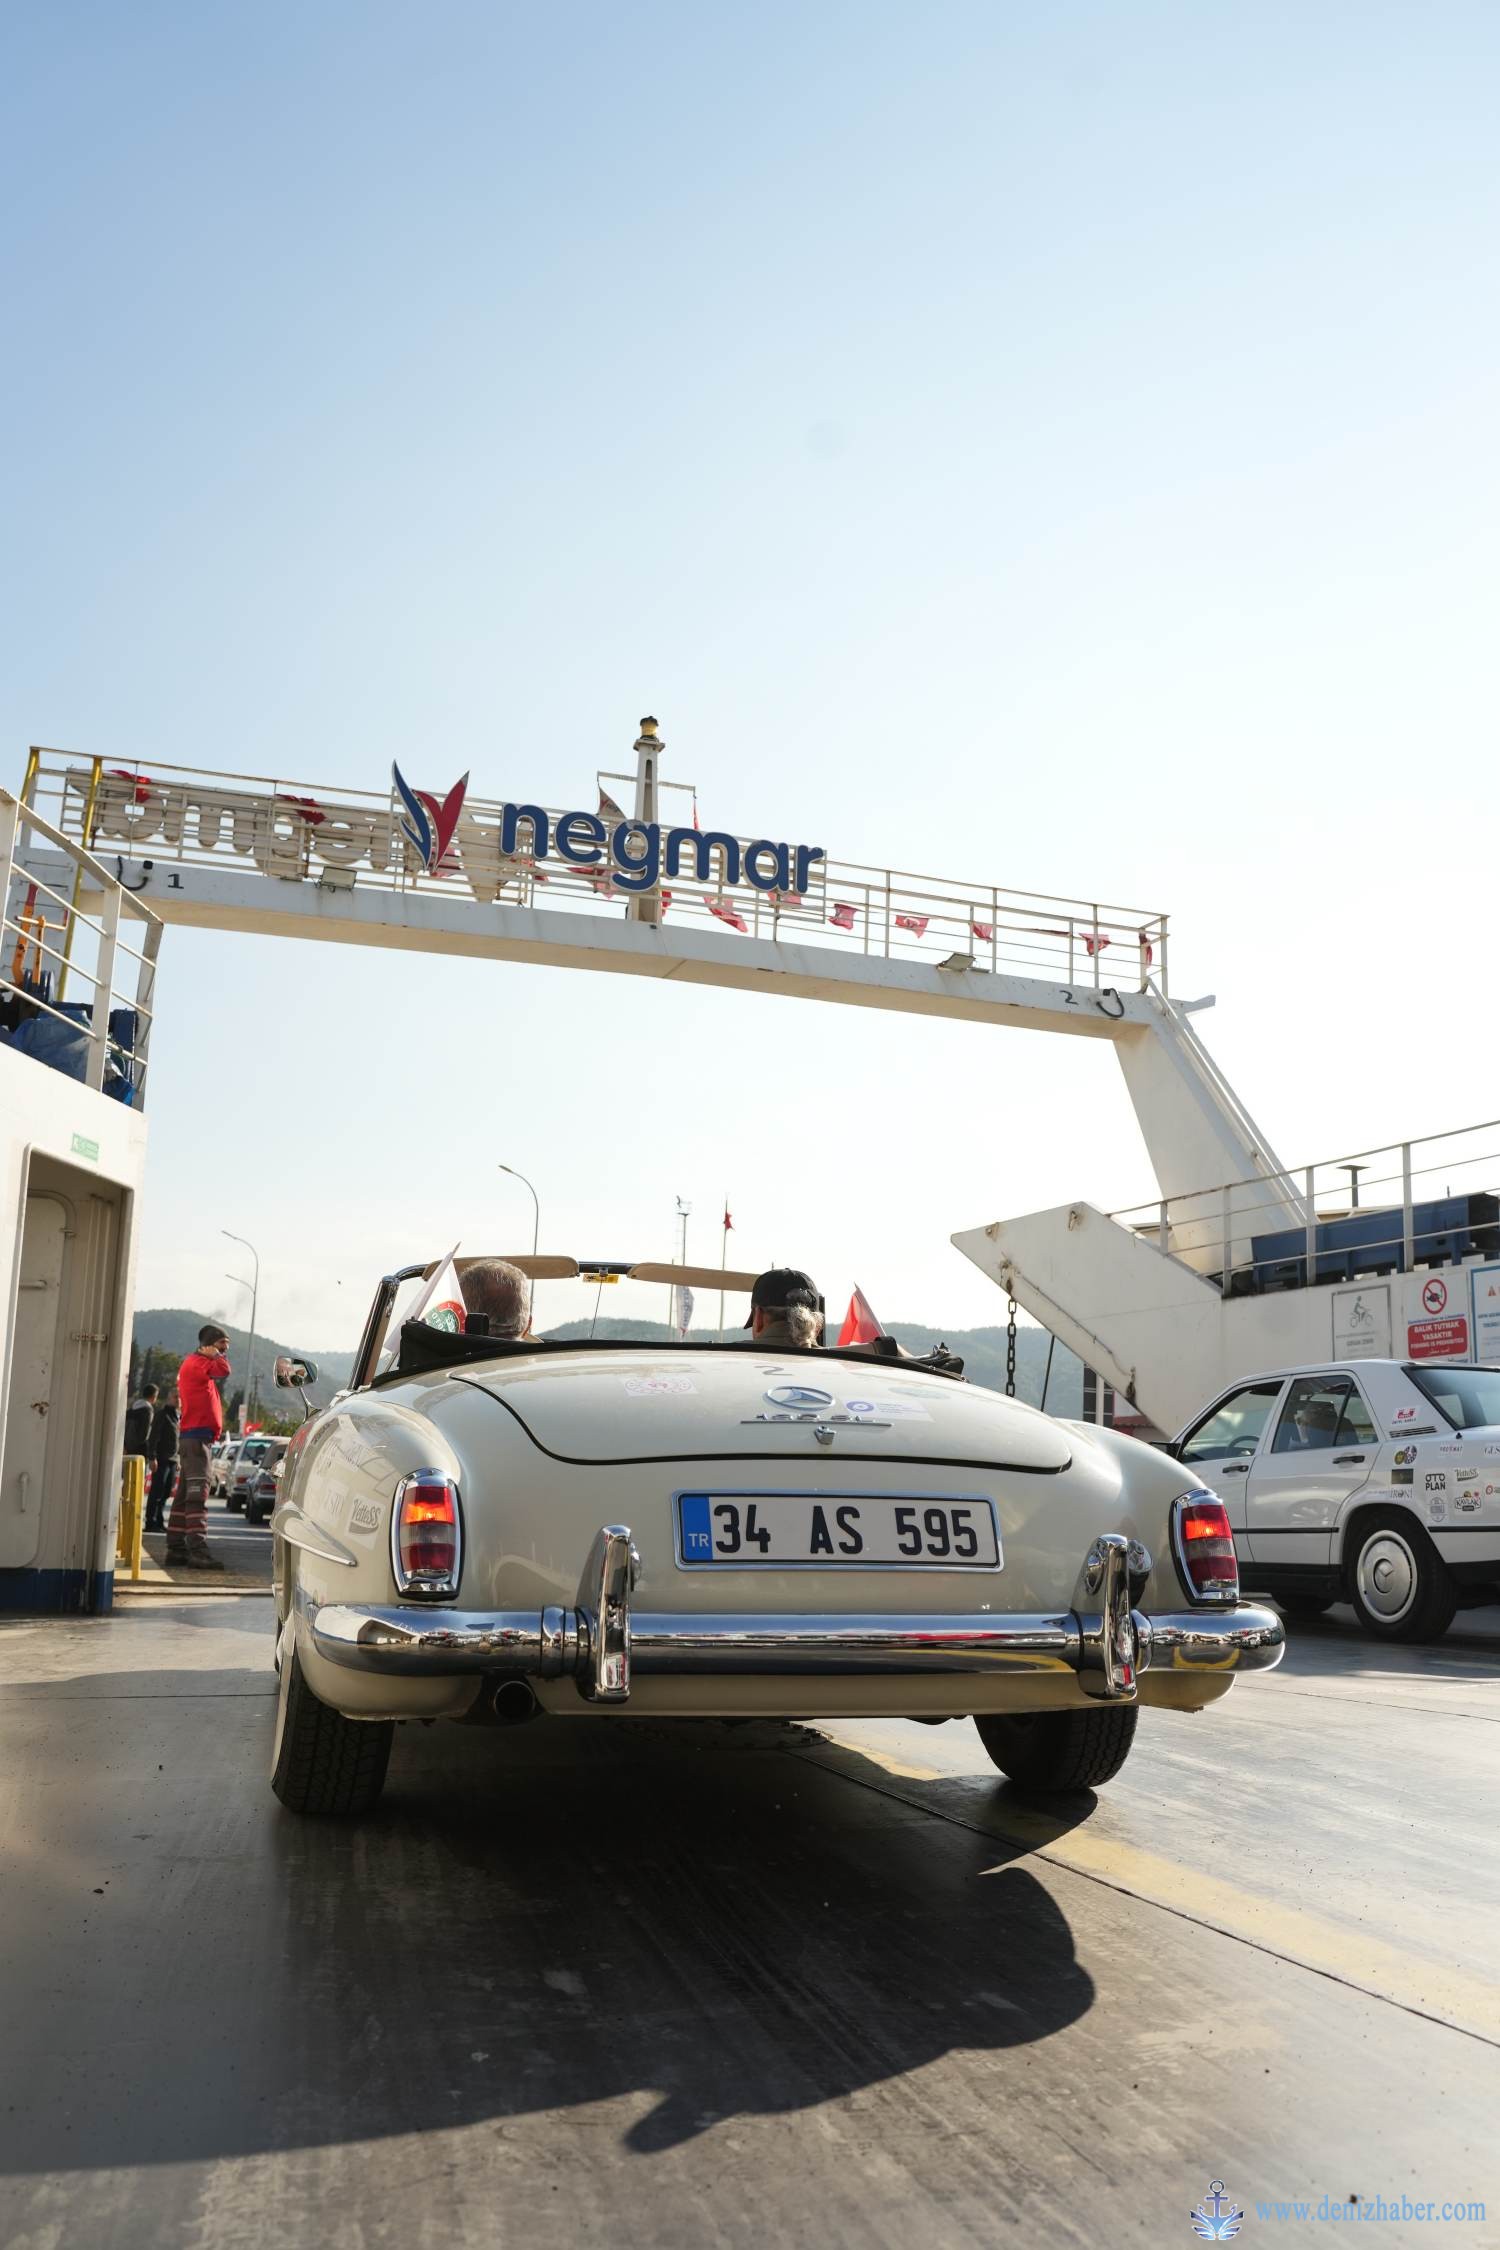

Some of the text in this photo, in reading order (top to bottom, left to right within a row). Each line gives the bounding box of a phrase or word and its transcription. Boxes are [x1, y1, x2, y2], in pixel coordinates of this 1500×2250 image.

[500, 801, 825, 894] negmar
[167, 873, 185, 890] 1
[1059, 990, 1079, 1006] 2
[1425, 1473, 1446, 1482] OTO
[1425, 1482, 1446, 1491] PLAN
[688, 1504, 979, 1558] TR 34 AS 595
